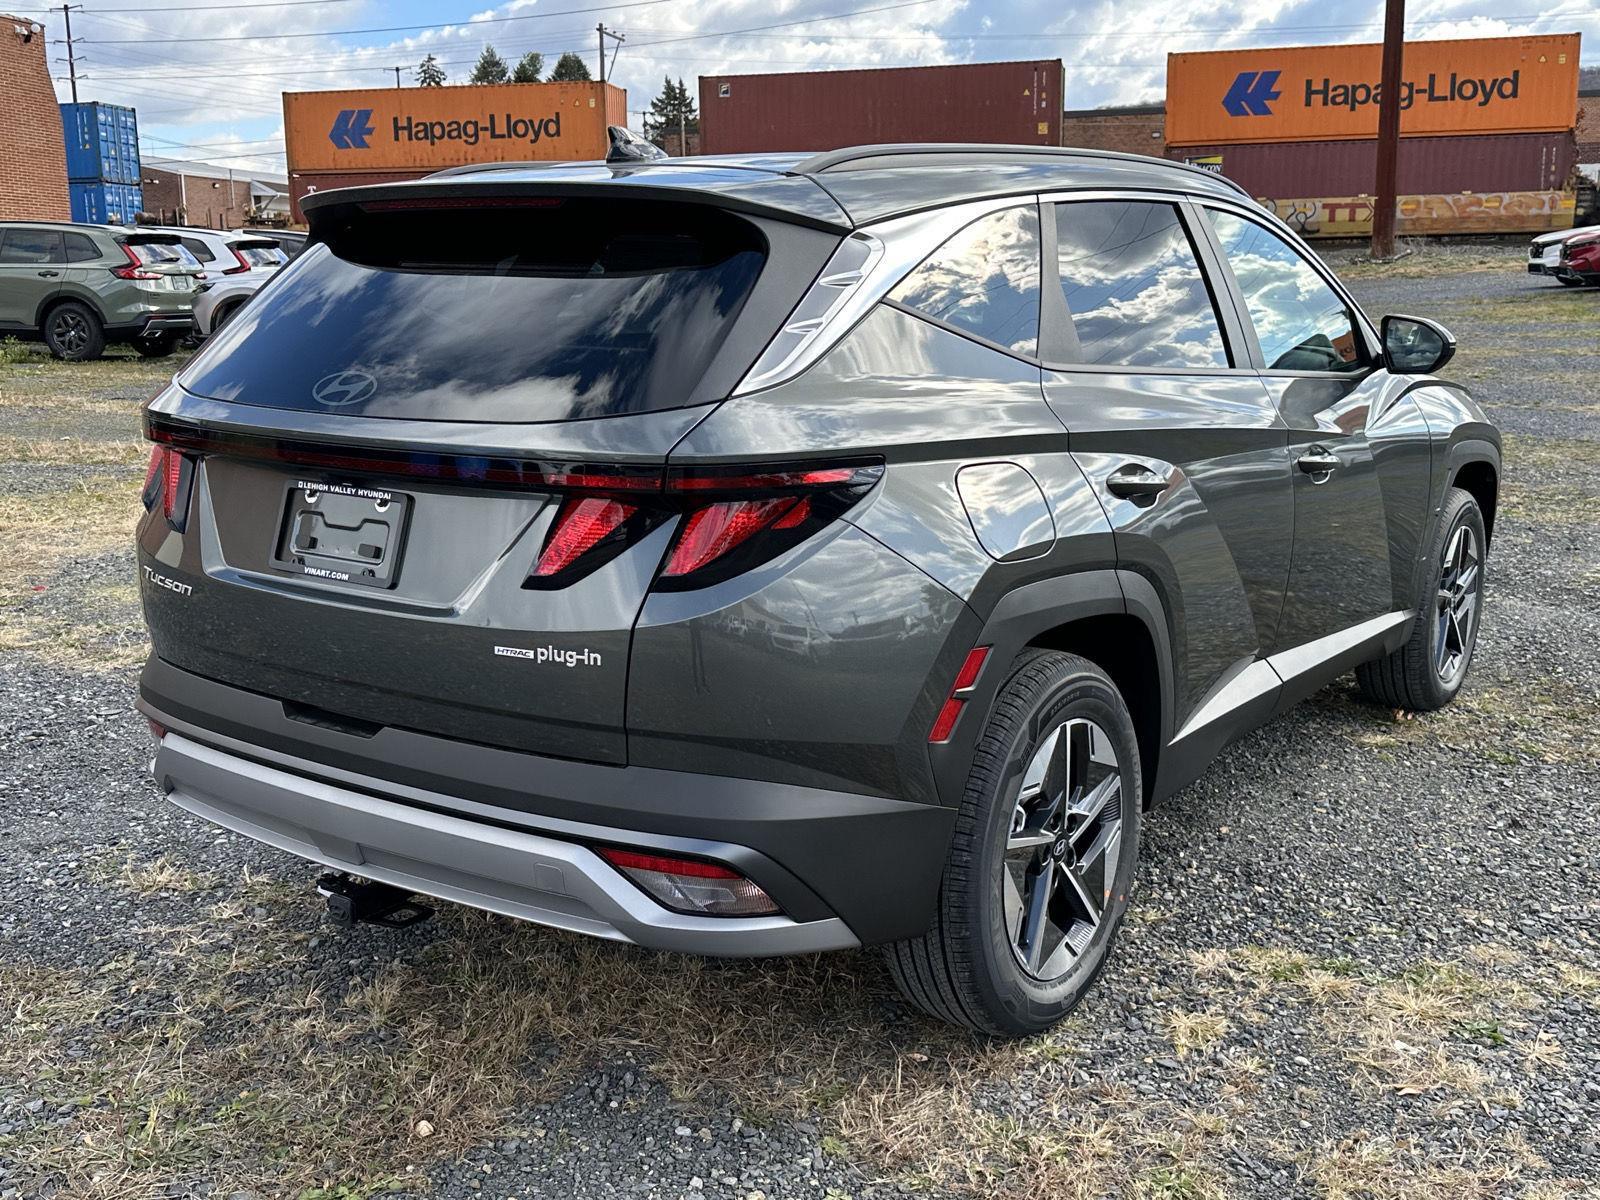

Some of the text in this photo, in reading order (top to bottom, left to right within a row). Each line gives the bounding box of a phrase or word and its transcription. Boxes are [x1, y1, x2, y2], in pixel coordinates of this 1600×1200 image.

[393, 112, 561, 146] Hapag-Lloyd
[330, 485, 356, 495] VALLEY
[358, 489, 391, 500] HYUNDAI
[304, 566, 349, 581] VINART.COM
[495, 645, 602, 668] HTRAC plug-in
